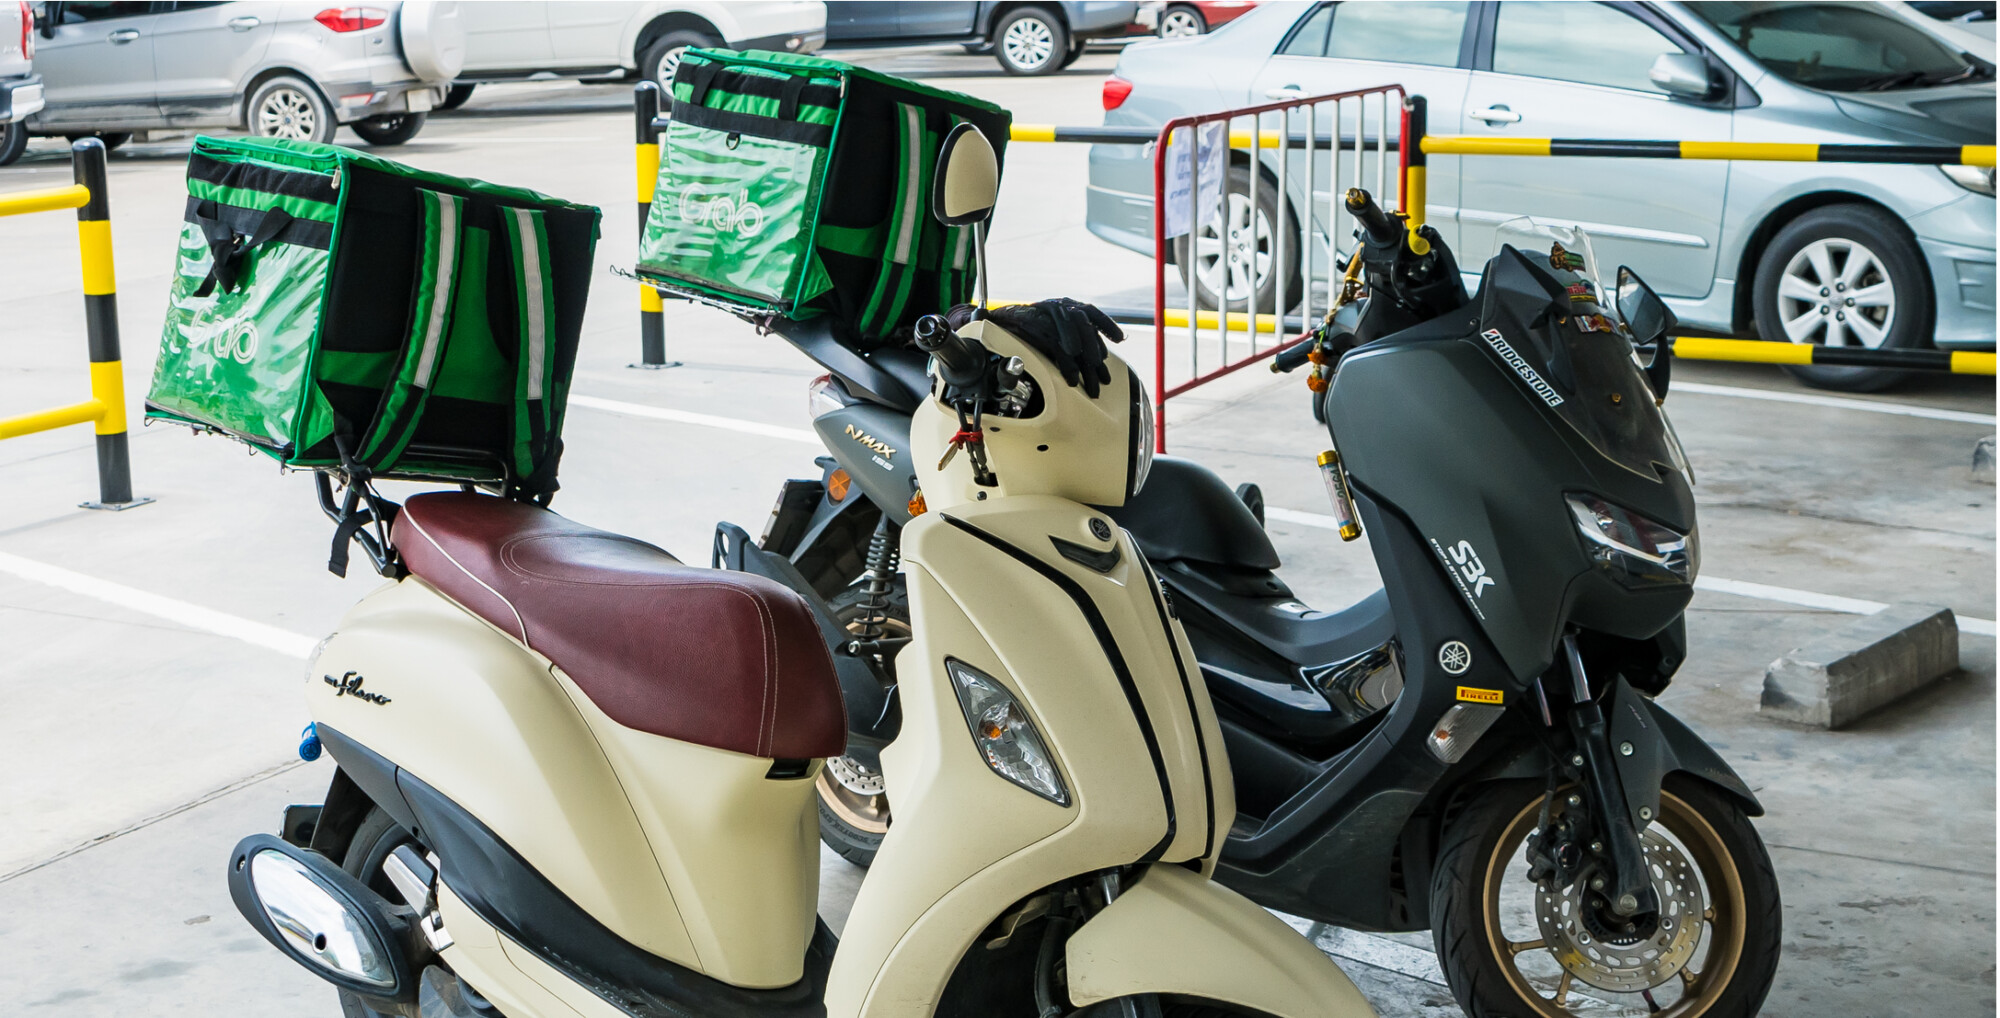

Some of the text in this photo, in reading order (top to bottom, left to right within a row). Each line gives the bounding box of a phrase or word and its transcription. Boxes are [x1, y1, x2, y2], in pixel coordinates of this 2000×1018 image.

[678, 182, 763, 238] Grab
[1483, 329, 1563, 406] BRIDGESTONE
[844, 423, 897, 459] NMAX
[1447, 540, 1496, 599] SBK
[1460, 688, 1500, 702] PIRELLI
